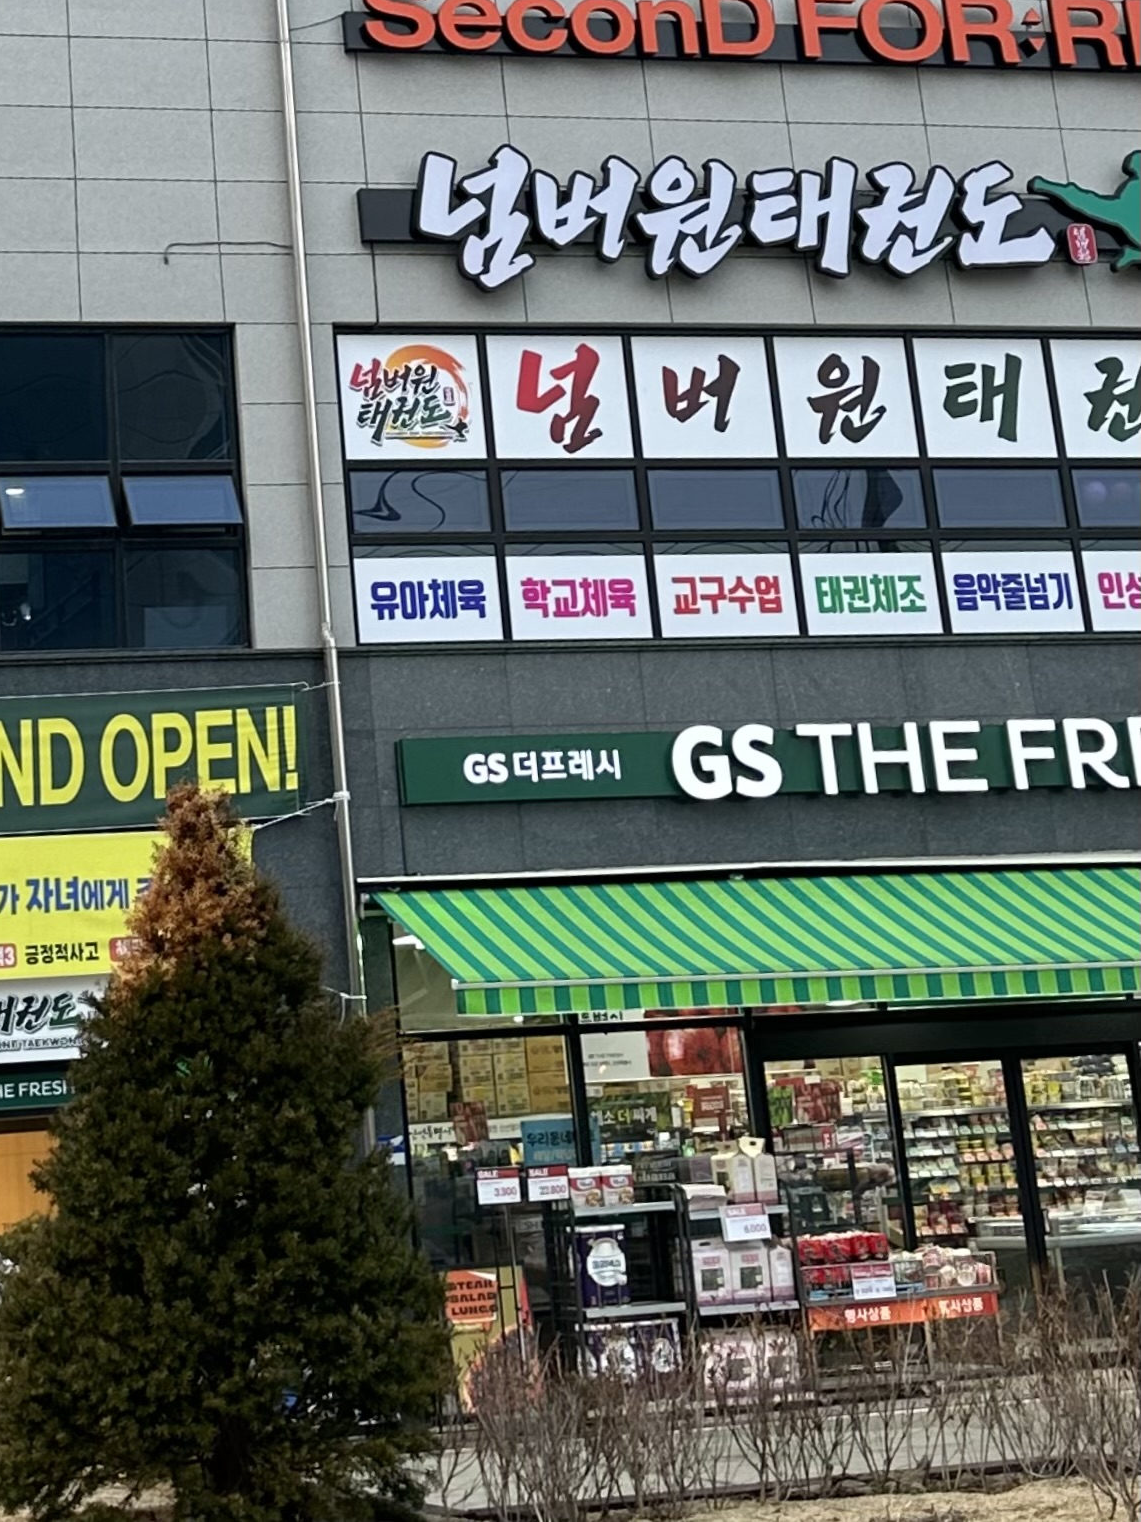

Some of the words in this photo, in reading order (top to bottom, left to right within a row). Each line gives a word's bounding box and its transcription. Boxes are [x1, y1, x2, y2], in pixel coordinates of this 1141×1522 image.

[417, 145, 1056, 290] 넘버원태권도
[349, 357, 440, 401] 넘버원
[356, 395, 454, 445] 태권도
[370, 579, 487, 620] 유아체육
[520, 577, 636, 618] 학교체육
[671, 575, 783, 615] 교구수업
[814, 574, 927, 614] 태권체조
[953, 572, 1074, 612] 음악줄넘기
[99, 705, 299, 803] OPEN!
[463, 753, 508, 784] GS
[512, 749, 621, 783] 더프레시
[671, 724, 783, 800] GS
[795, 720, 989, 795] THE
[25, 876, 130, 914] 자녀에게
[25, 941, 100, 965] 긍정적사고
